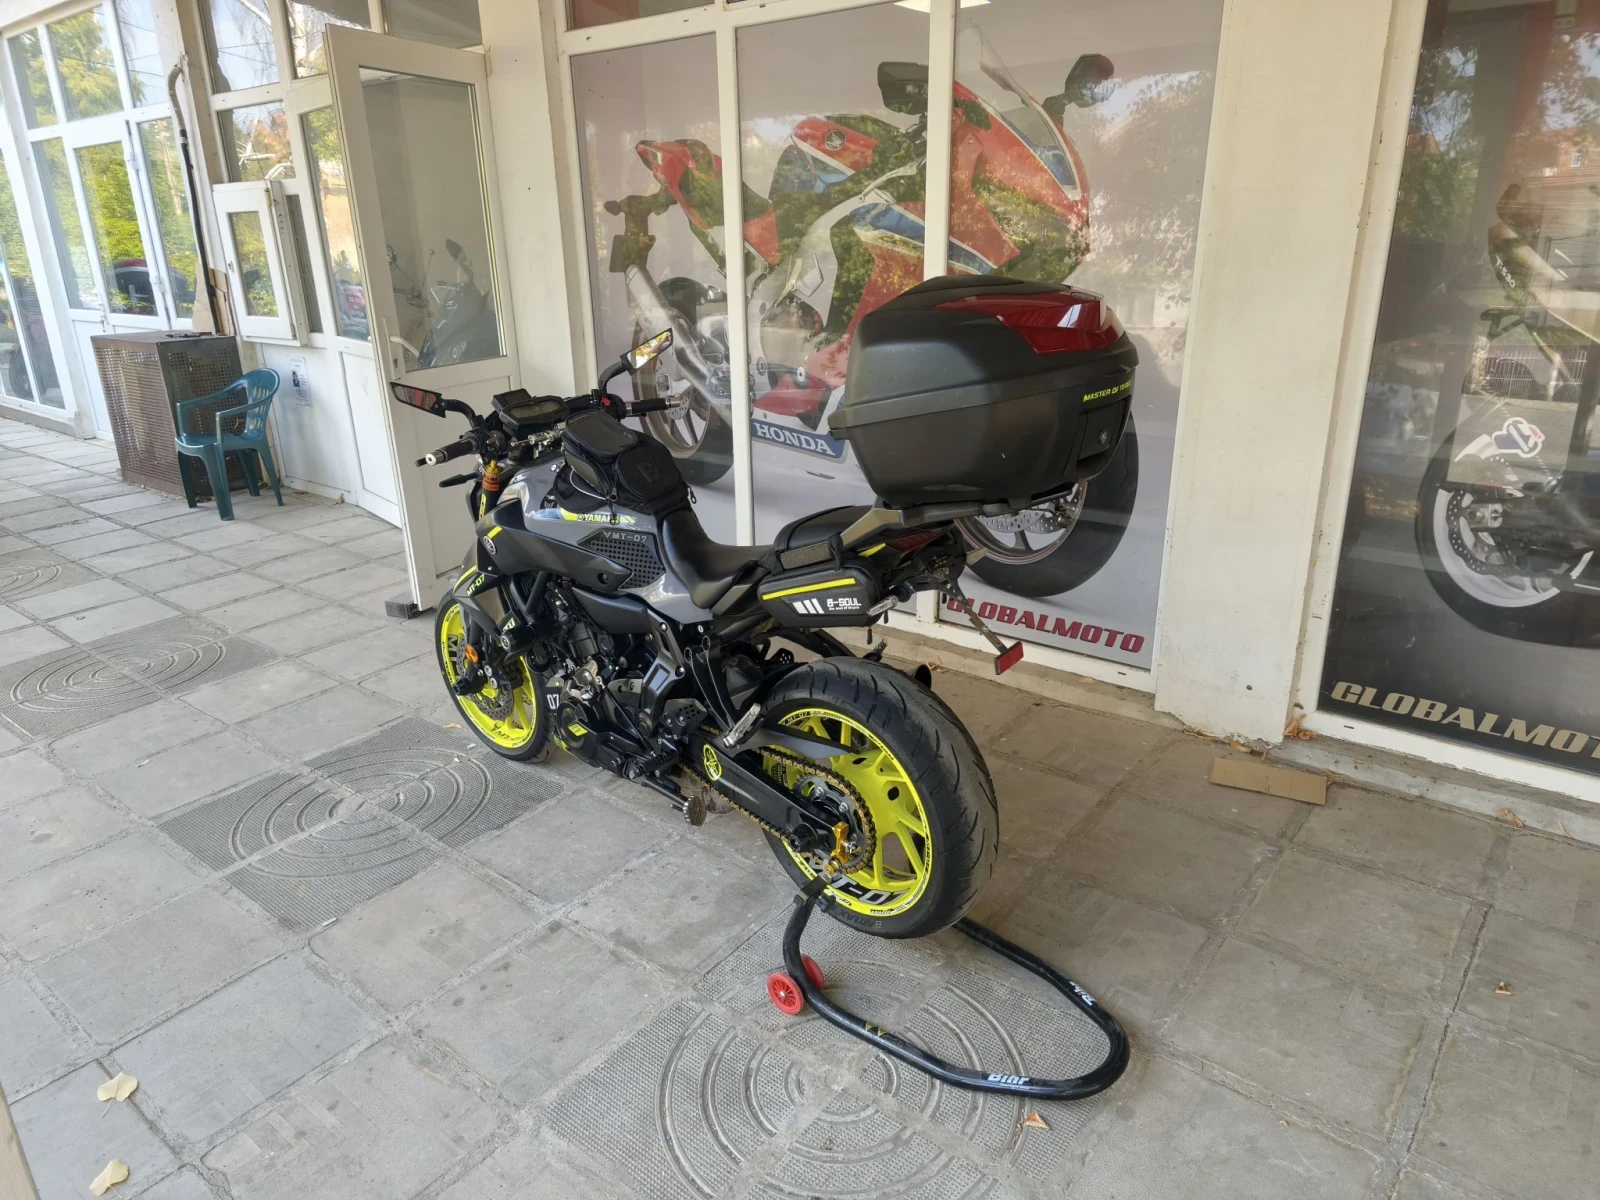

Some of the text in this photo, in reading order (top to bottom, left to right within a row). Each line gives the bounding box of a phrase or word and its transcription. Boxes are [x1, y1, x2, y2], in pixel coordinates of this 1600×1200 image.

[1082, 388, 1111, 402] MASTER
[753, 422, 836, 456] HONDA
[612, 531, 647, 543] MT-07
[466, 573, 485, 597] MT-07
[546, 693, 560, 710] 07
